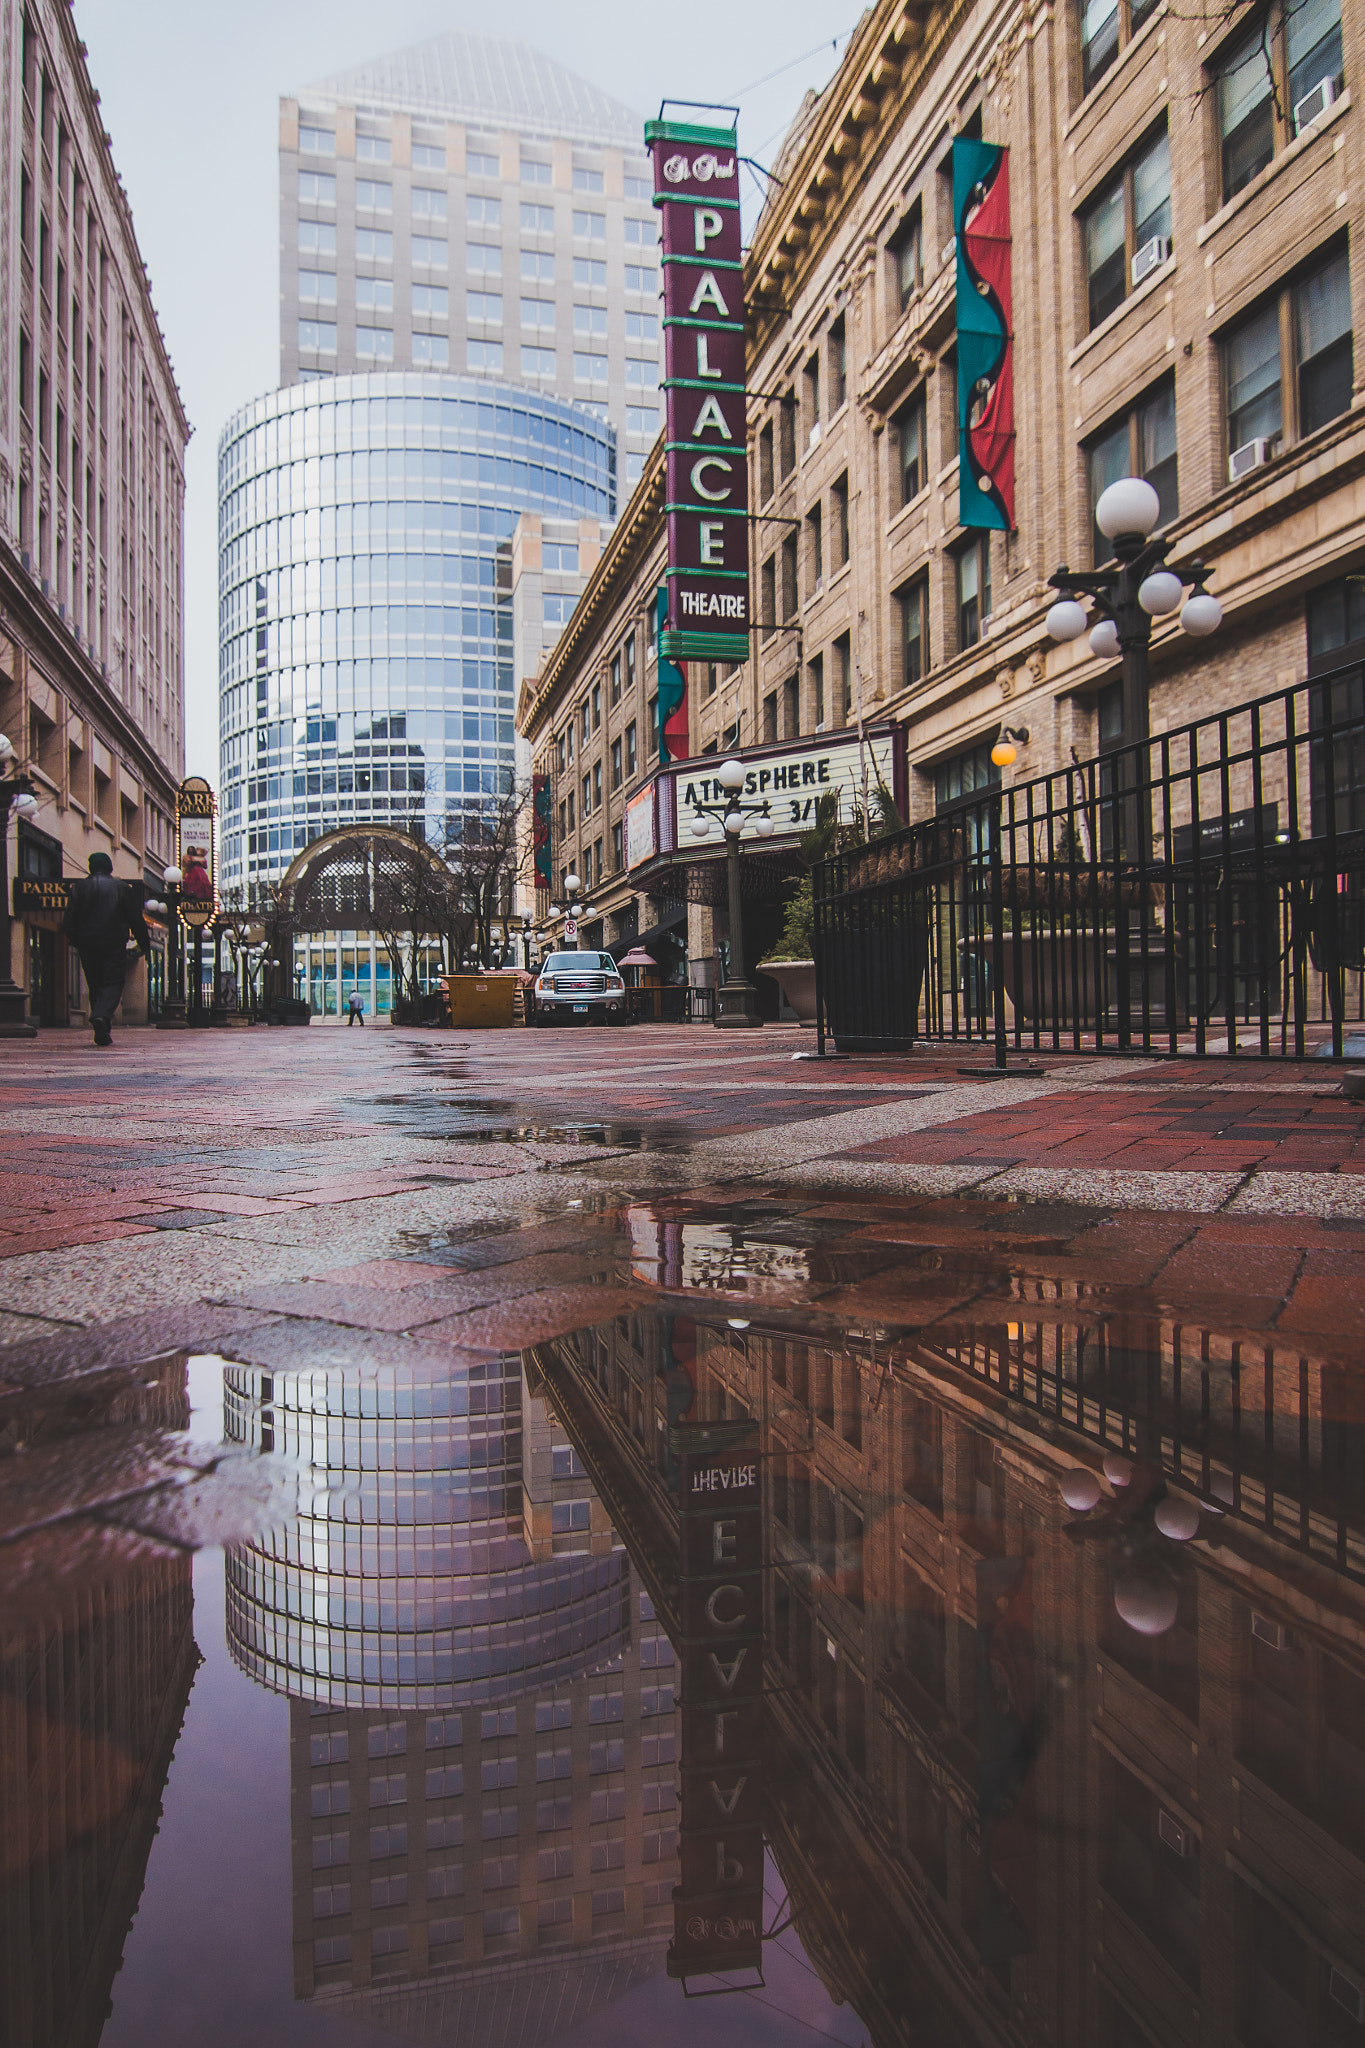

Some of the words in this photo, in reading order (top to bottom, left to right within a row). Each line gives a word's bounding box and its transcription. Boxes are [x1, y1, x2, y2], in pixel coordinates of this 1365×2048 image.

[689, 208, 733, 565] PALACE
[680, 591, 746, 618] THEATRE
[684, 758, 830, 805] ATMSPHERE
[22, 881, 67, 895] PARK
